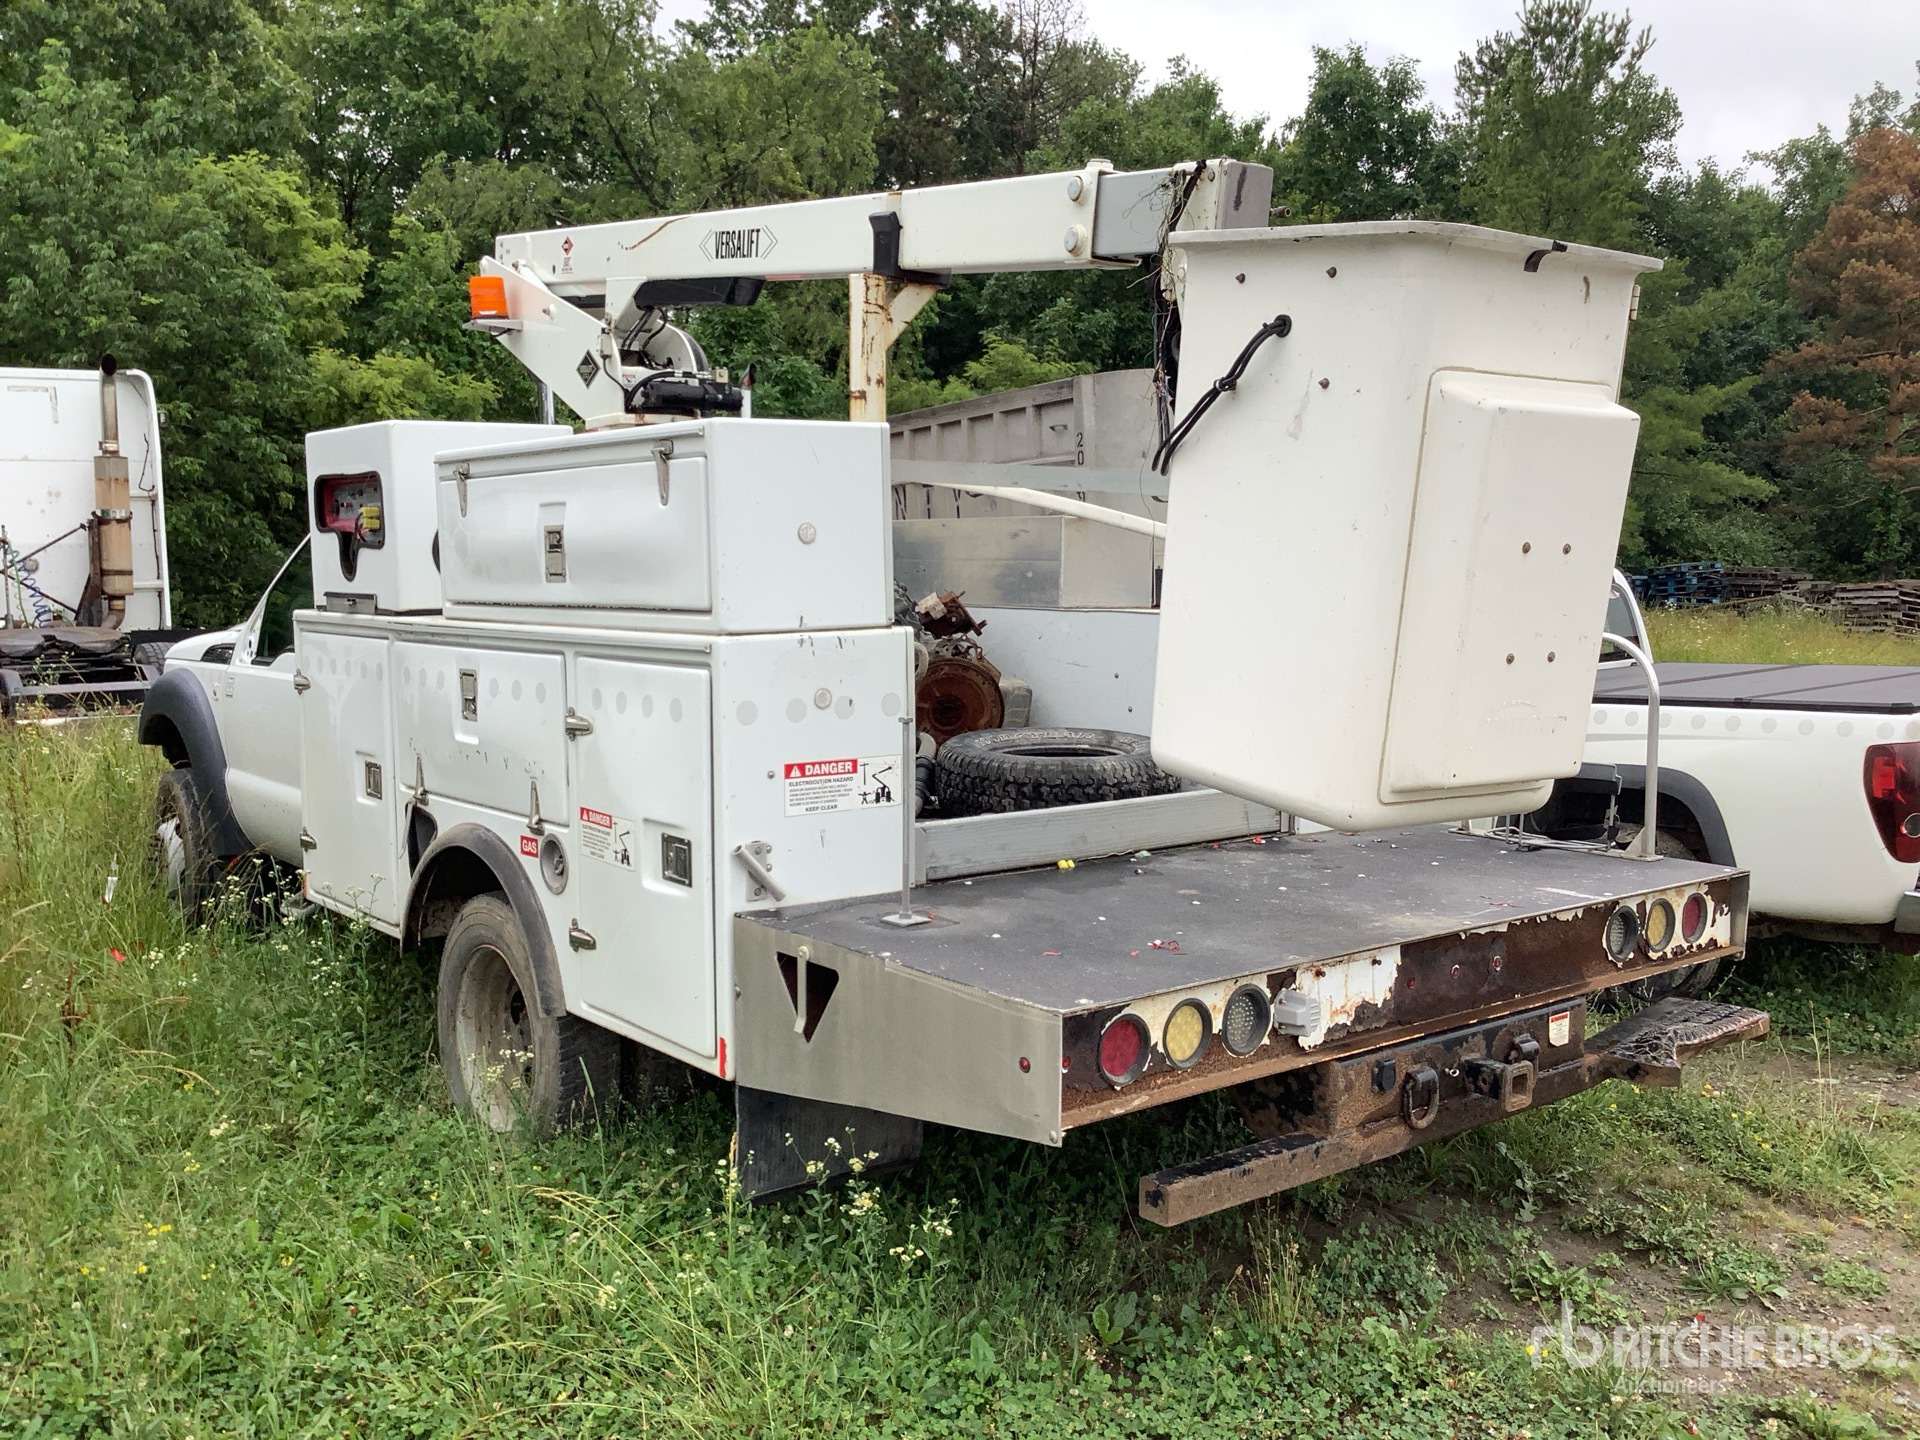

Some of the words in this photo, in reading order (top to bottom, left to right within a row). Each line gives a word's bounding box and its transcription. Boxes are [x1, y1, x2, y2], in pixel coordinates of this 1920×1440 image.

[715, 228, 761, 260] VERSALIFT
[805, 761, 853, 776] DANGER
[789, 777, 832, 788] ELECTROCUTION
[588, 810, 611, 828] DANGER
[522, 839, 537, 854] GAS
